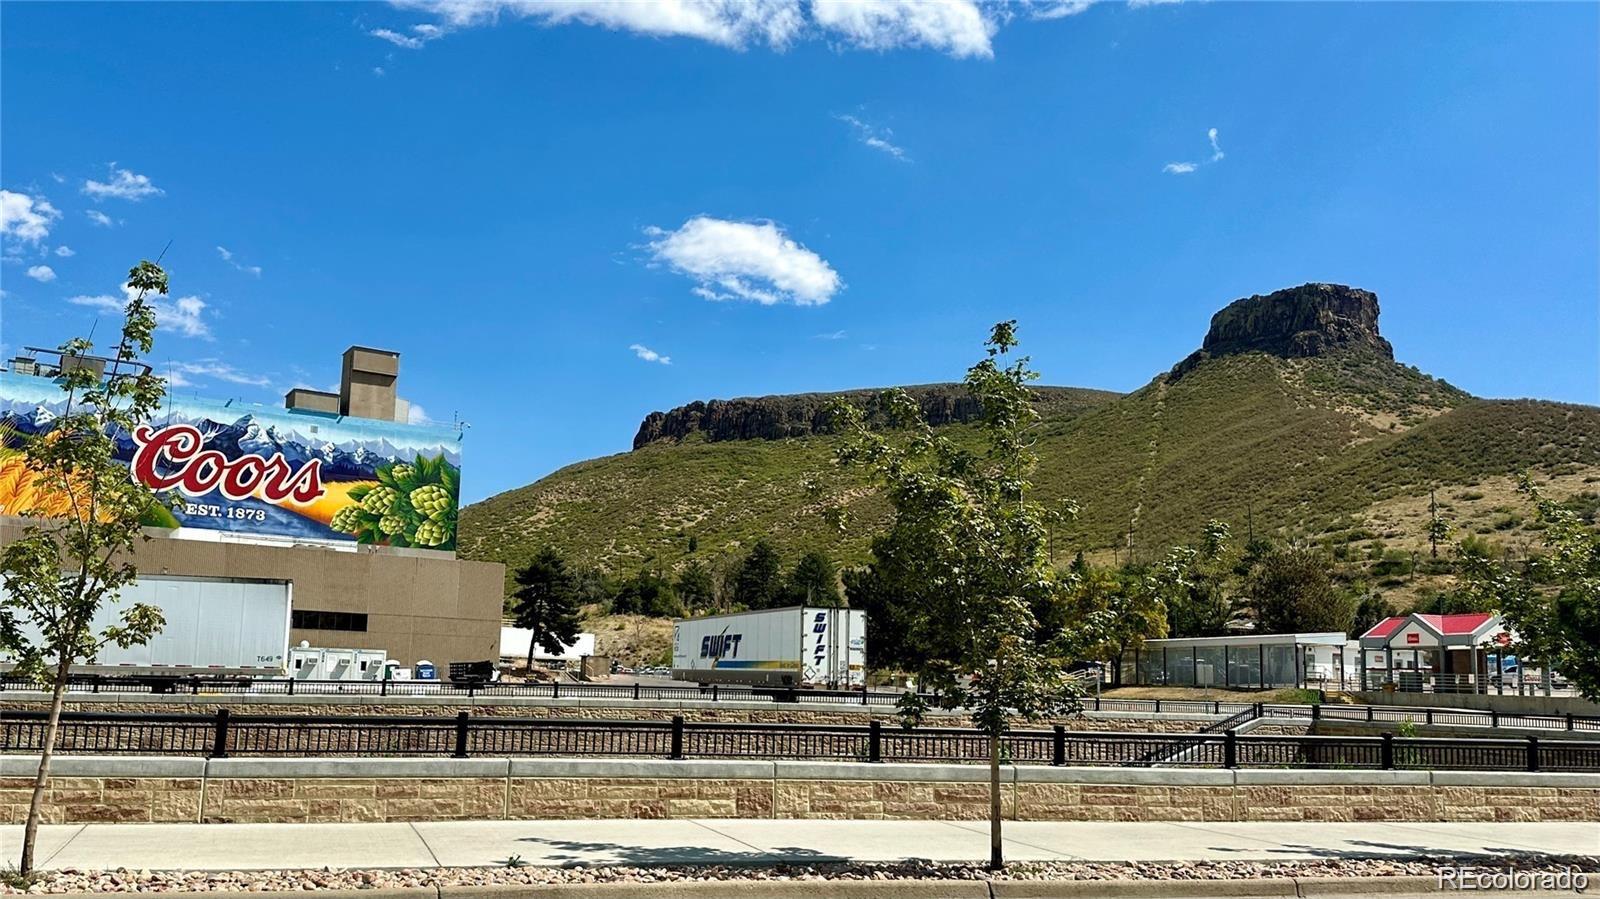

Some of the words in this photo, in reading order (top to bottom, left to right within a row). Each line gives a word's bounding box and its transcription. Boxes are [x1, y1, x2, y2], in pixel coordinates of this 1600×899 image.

[132, 424, 326, 504] Coors
[185, 503, 222, 517] EST.
[227, 507, 266, 521] 1873
[700, 632, 742, 659] SWIFT
[813, 612, 827, 666] SWIFT
